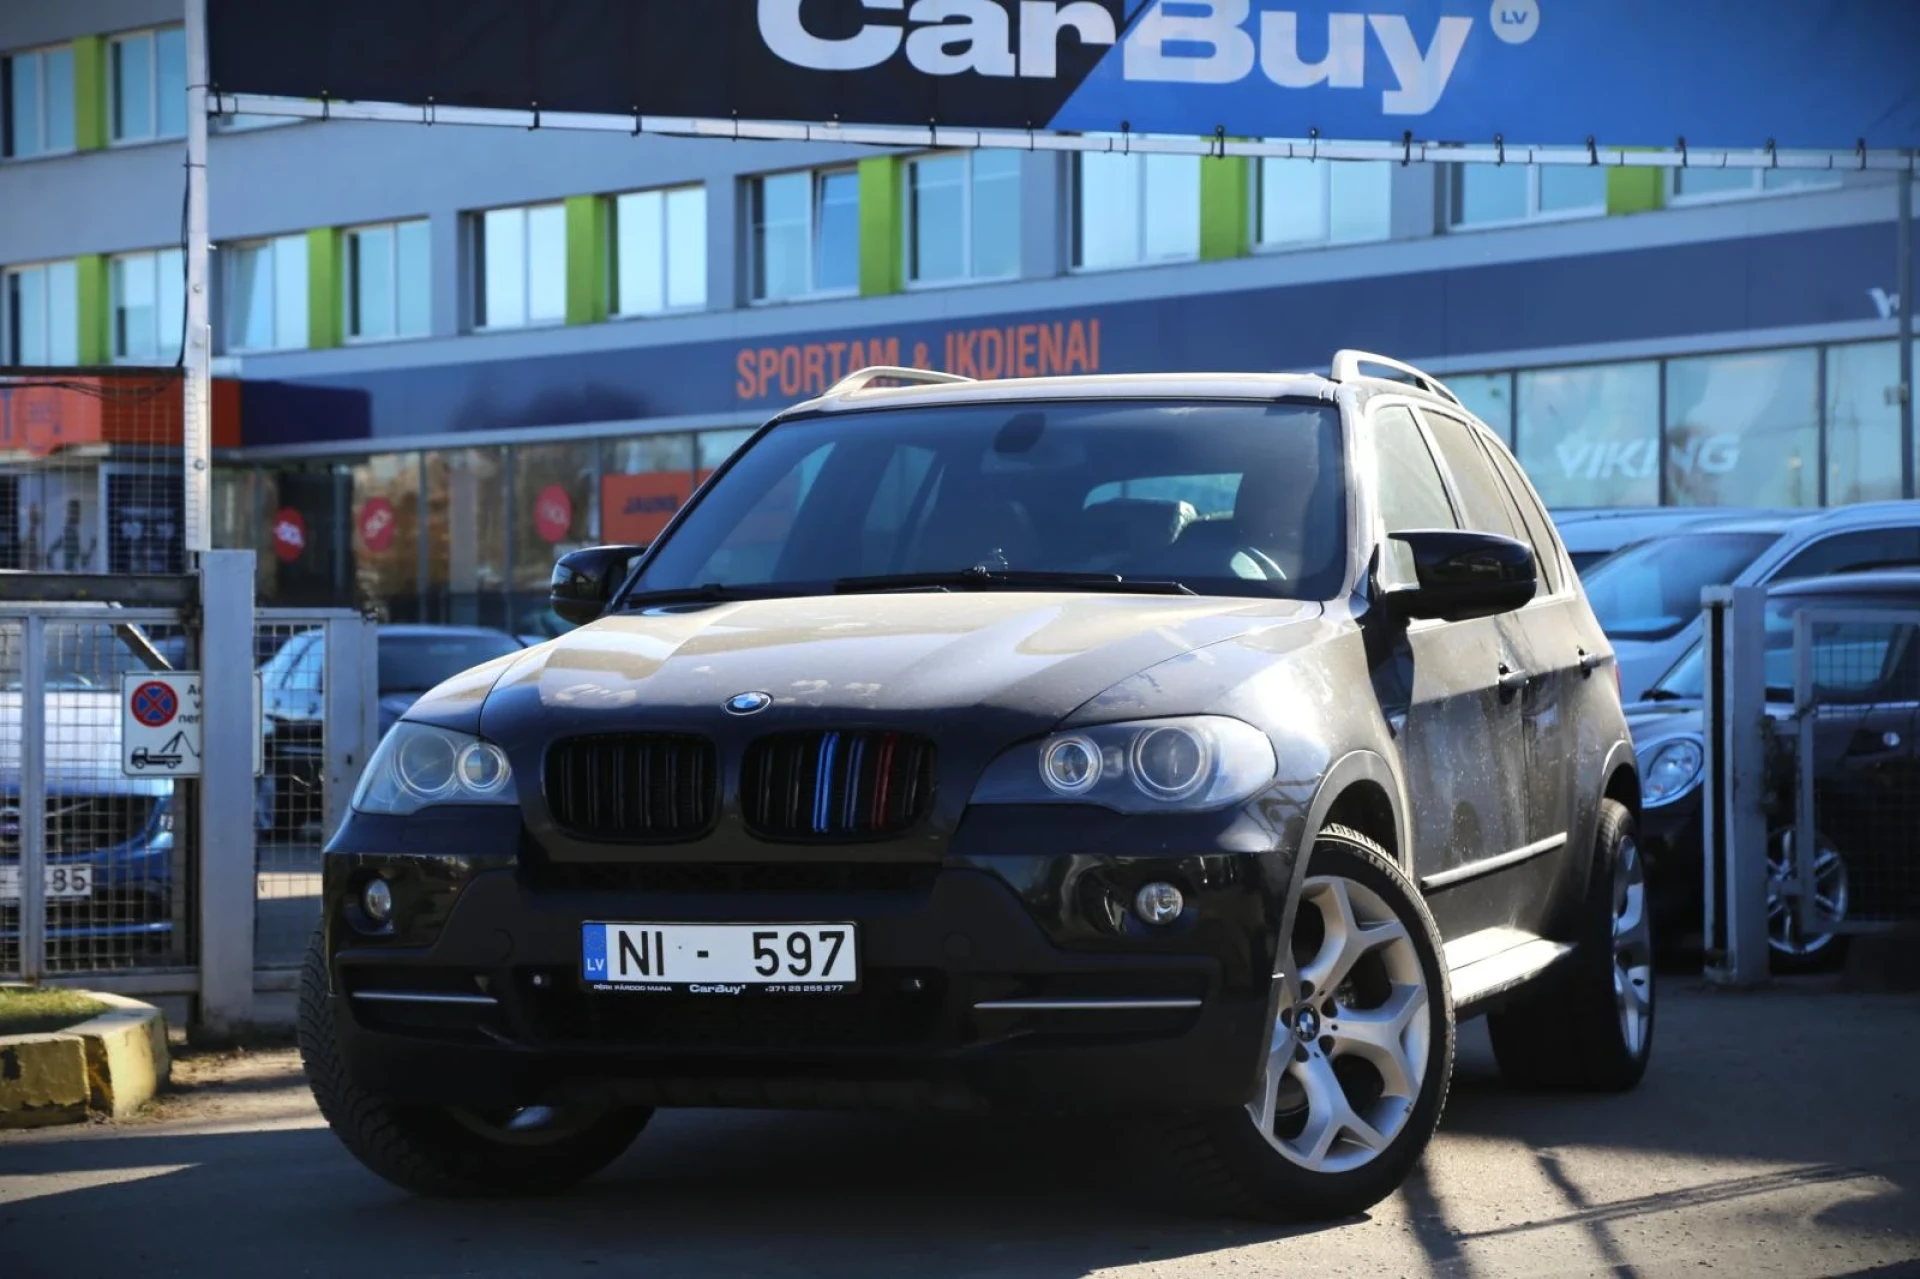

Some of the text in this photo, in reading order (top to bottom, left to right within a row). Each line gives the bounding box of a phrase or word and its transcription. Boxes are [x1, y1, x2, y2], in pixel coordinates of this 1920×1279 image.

[1501, 10, 1529, 25] LV
[757, 0, 1473, 115] CarBuy
[736, 318, 1100, 399] SPORTAM & IKDIENAI
[1555, 434, 1741, 479] VIKING
[46, 868, 87, 892] 85
[586, 958, 605, 972] LV
[618, 930, 665, 976] NI
[752, 931, 846, 977] 597
